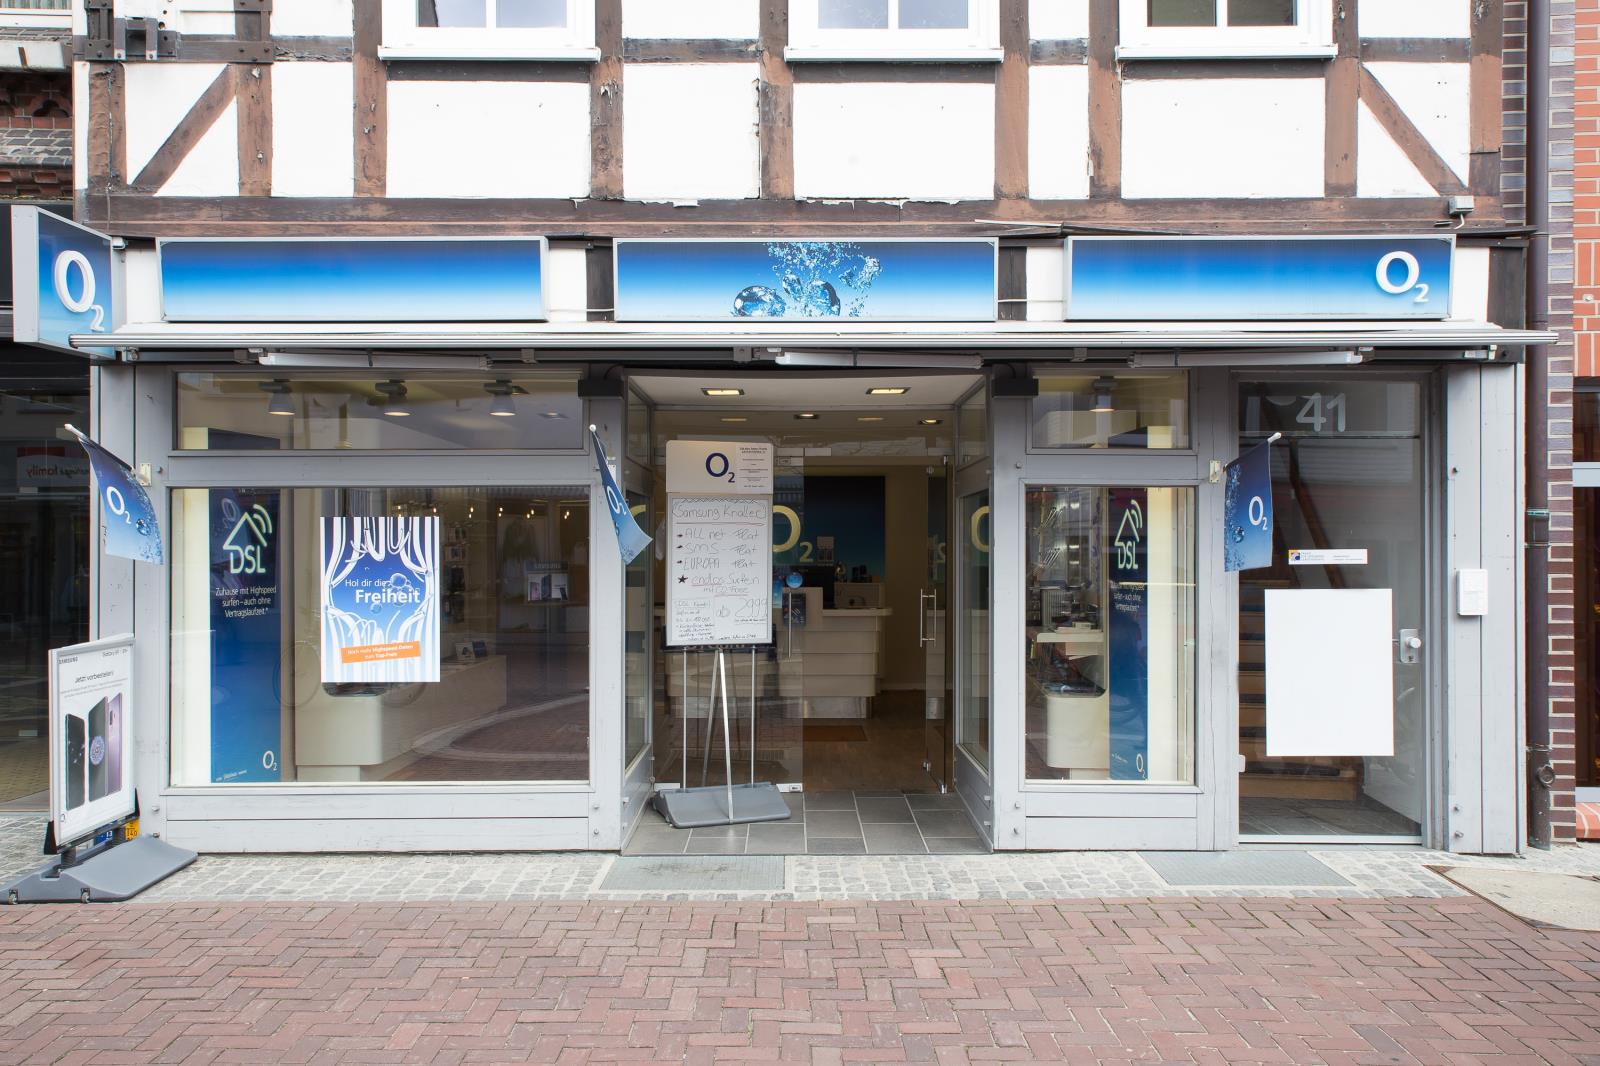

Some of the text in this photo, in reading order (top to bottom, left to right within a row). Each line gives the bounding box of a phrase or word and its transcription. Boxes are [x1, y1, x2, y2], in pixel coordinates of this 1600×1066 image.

[55, 250, 104, 332] O2
[1375, 250, 1430, 303] O2
[1296, 392, 1346, 432] 41
[705, 452, 736, 483] O2
[106, 486, 132, 524] O2
[674, 504, 720, 520] Samsung
[1248, 495, 1268, 531] O2
[228, 544, 266, 574] DSL
[1117, 540, 1139, 570] DSL
[215, 584, 277, 597] Zuhause mit Highspeed
[345, 579, 359, 588] Hol
[361, 579, 373, 587] dir
[355, 588, 421, 604] Freiheit
